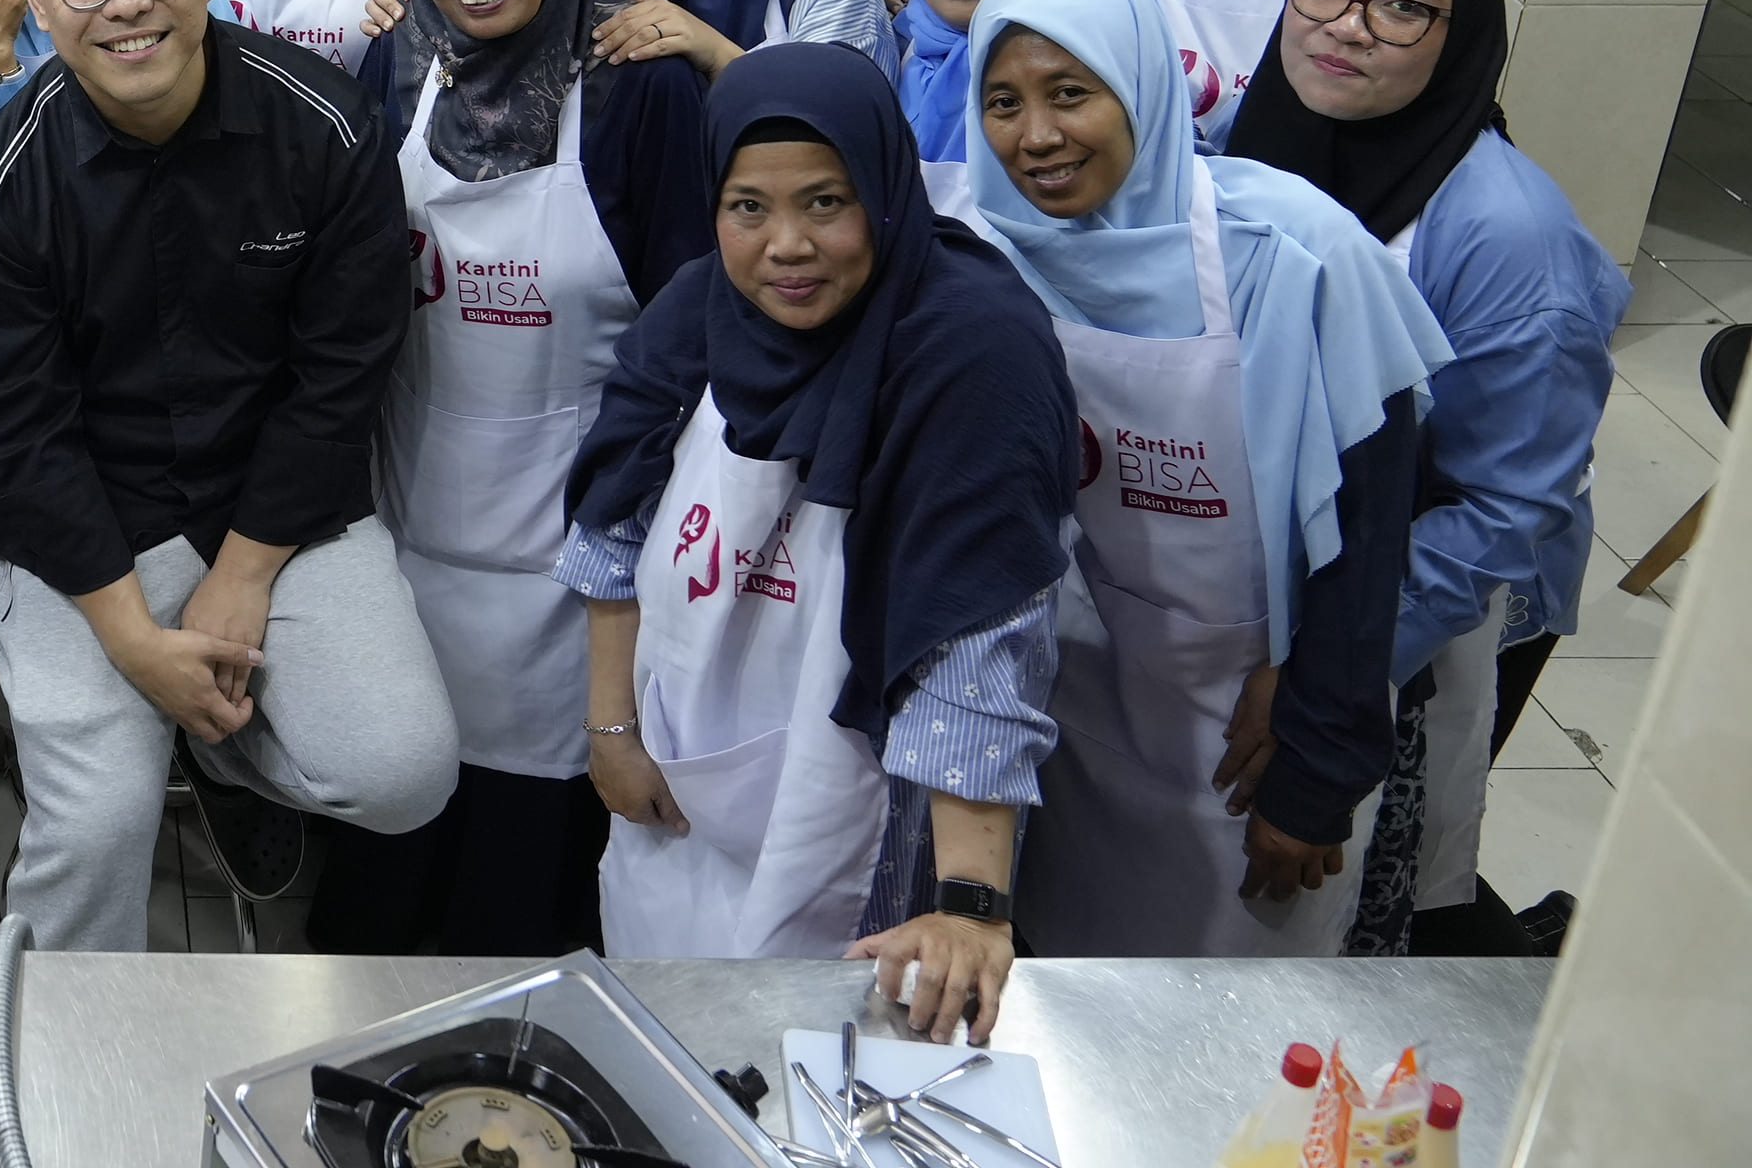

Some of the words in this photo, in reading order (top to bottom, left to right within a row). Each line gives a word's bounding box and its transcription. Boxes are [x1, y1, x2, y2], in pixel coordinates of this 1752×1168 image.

[272, 26, 344, 44] Kartini
[456, 260, 539, 277] Kartini
[458, 279, 547, 307] BISA
[467, 311, 501, 322] Bikin
[504, 313, 547, 324] Usaha
[1116, 428, 1205, 460] Kartini
[1118, 452, 1219, 493] BISA
[1128, 492, 1166, 510] Bikin
[1170, 500, 1221, 516] Usaha
[751, 577, 793, 599] Usaha
